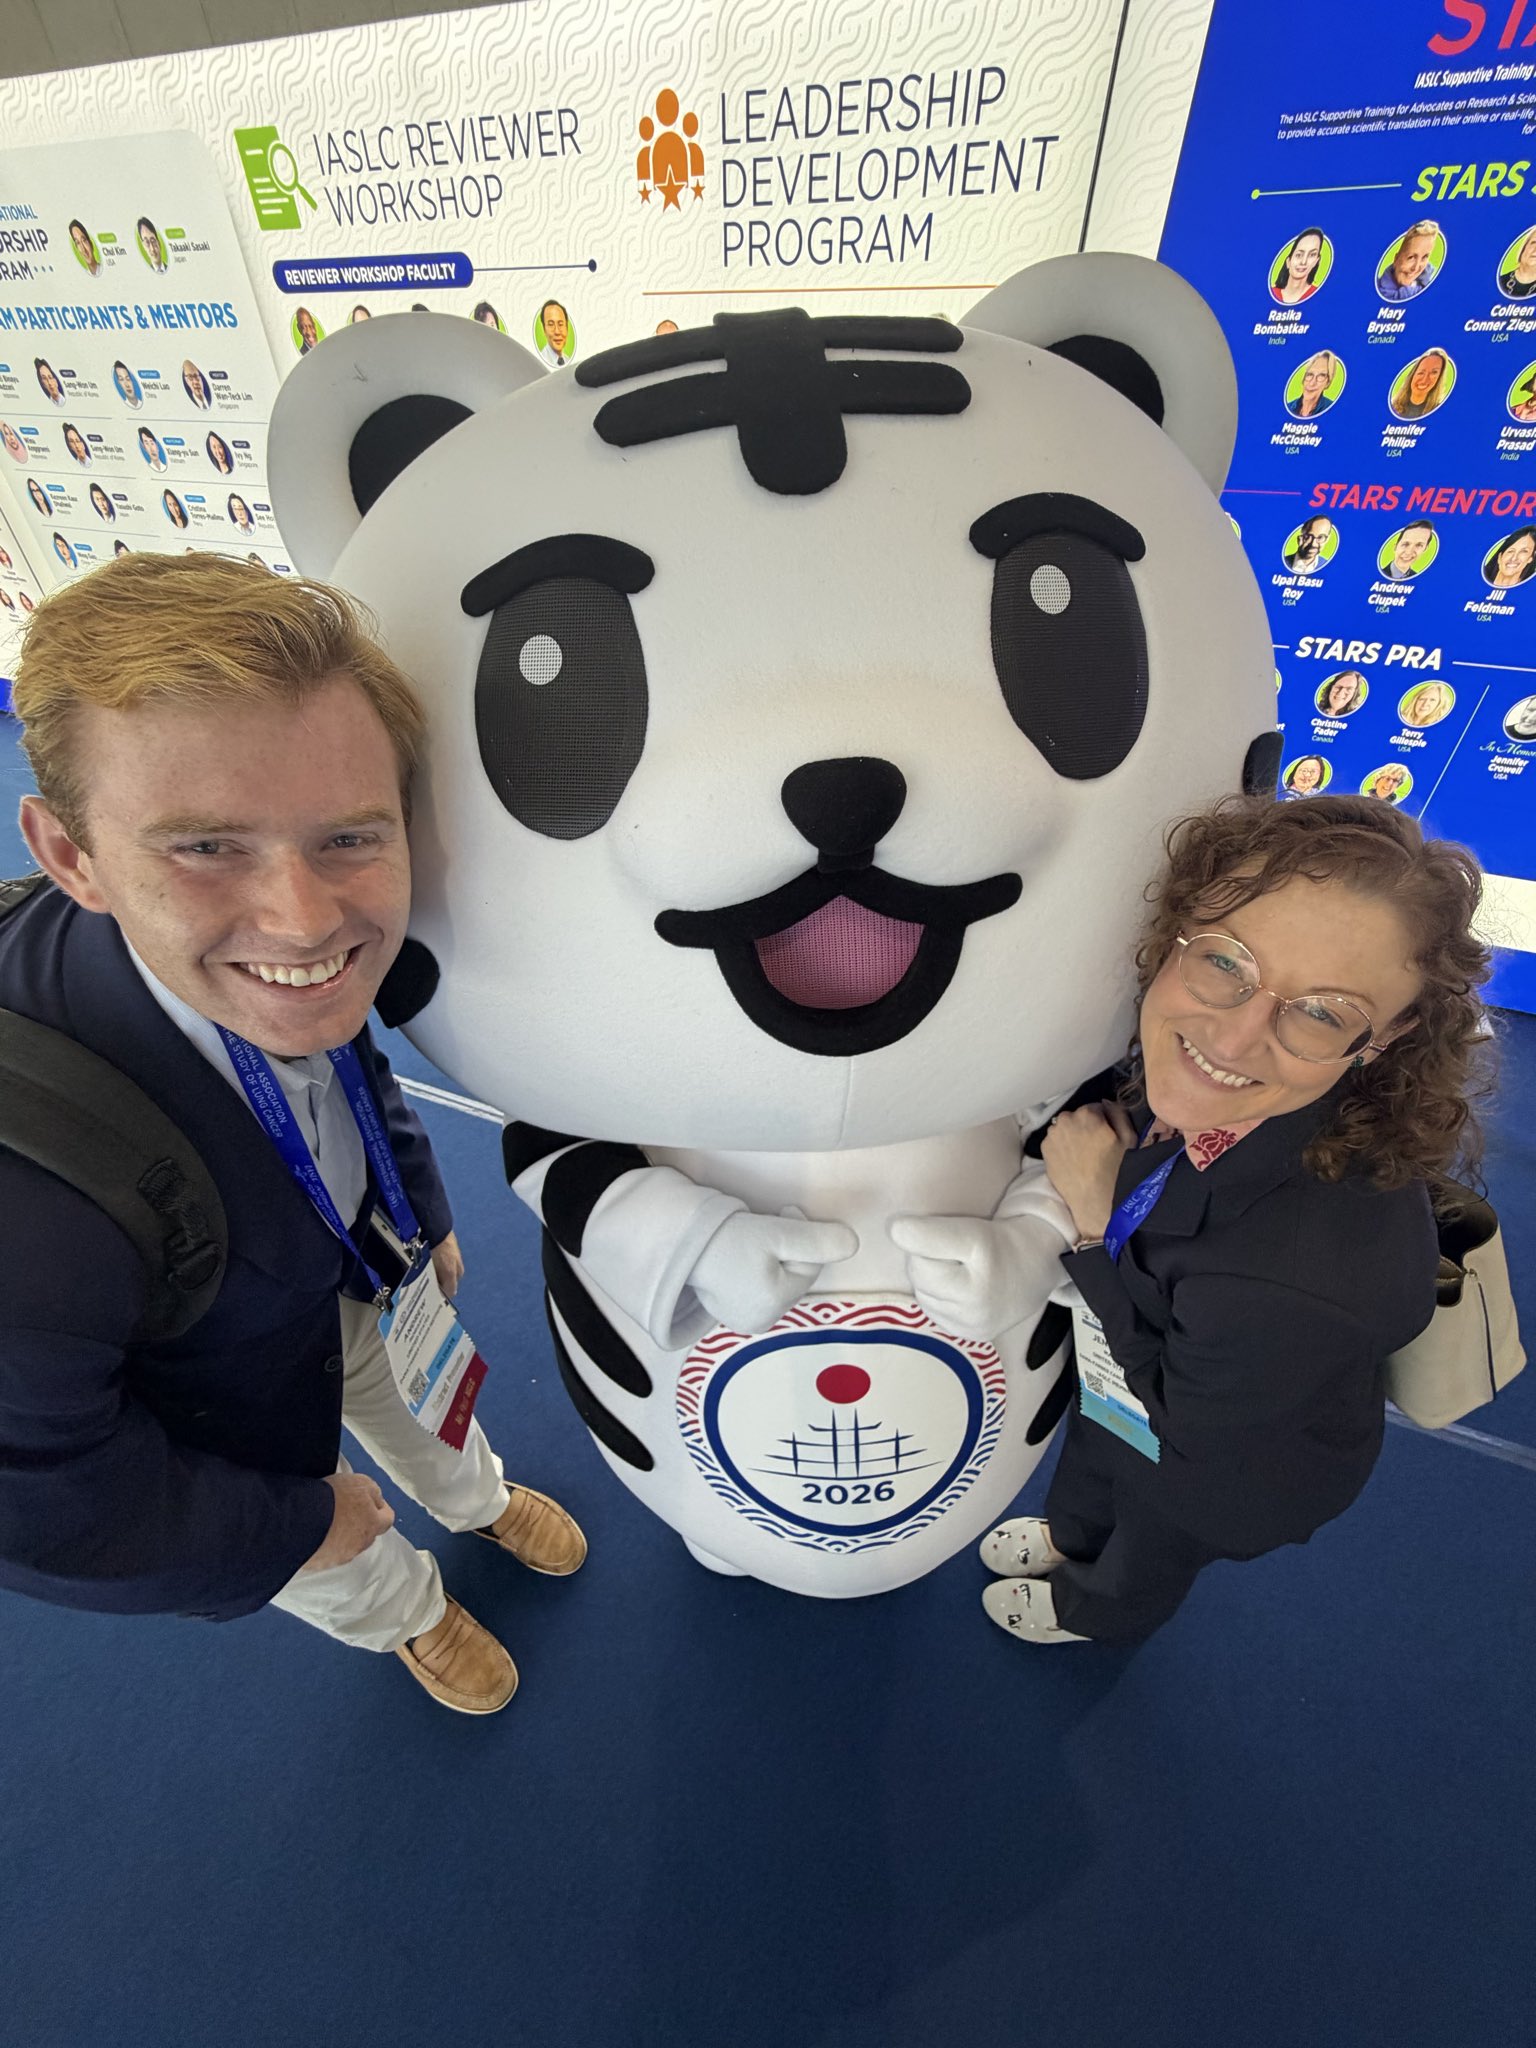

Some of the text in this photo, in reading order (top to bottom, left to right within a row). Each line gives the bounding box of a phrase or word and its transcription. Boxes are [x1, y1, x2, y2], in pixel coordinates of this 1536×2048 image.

[1414, 62, 1535, 89] IASLC Supportive Training
[721, 66, 1006, 145] LEADERSHIP
[1280, 114, 1294, 124] The
[1294, 111, 1319, 123] IASLC
[1320, 109, 1362, 122] Supportive
[1364, 105, 1395, 118] Training
[1396, 103, 1409, 115] for
[1409, 101, 1454, 114] Advocates
[1455, 100, 1466, 110] on
[1467, 95, 1507, 109] Research
[1508, 94, 1515, 105] &
[1277, 108, 1534, 140] to provide accurate scientific translation in their online or real-life
[313, 108, 582, 176] IASLC REVIEWER
[722, 135, 1059, 208] DEVELOPMENT
[1411, 160, 1531, 202] STARS
[324, 174, 503, 227] WORKSHOP
[723, 212, 933, 267] PROGRAM
[284, 263, 456, 286] REVIEWER WORKSHOP FACULTY
[15, 305, 134, 330] PARTICIPANTS
[134, 304, 149, 330] &
[148, 302, 238, 329] MENTORS
[1268, 309, 1302, 322] Rasika
[1377, 307, 1406, 320] Mary
[1490, 303, 1535, 317] Colleen
[1253, 323, 1310, 335] Bombatkar
[1367, 321, 1406, 334] Bryson
[1464, 319, 1506, 332] Conner
[1268, 337, 1286, 345] India
[1367, 335, 1396, 344] Canada
[1491, 333, 1509, 343] USA
[1282, 423, 1318, 435] Maggie
[1382, 424, 1426, 436] Jennifer
[1270, 435, 1322, 447] McCloskey
[1381, 437, 1416, 449] Philips
[1496, 439, 1536, 451] Prasad
[1386, 449, 1402, 457] USA
[1500, 452, 1520, 461] India
[1309, 483, 1403, 511] STARS
[1272, 574, 1324, 588] Upal Basu
[1370, 581, 1415, 594] Andrew
[1282, 588, 1304, 600] Roy
[1486, 590, 1507, 601] Jill
[1464, 601, 1515, 615] Feldman
[1476, 614, 1492, 622] USA
[1295, 636, 1441, 671] STARS PRA
[1311, 718, 1348, 730] Christine
[1313, 727, 1339, 737] Fader
[1401, 728, 1424, 739] Terry
[1389, 736, 1427, 748] Gillespie
[1490, 755, 1529, 767] Jennifer
[233, 1045, 283, 1138] STUDY OF LUNG CANCER
[257, 1072, 288, 1123] ASSOCIATION
[802, 1480, 895, 1505] 2026
